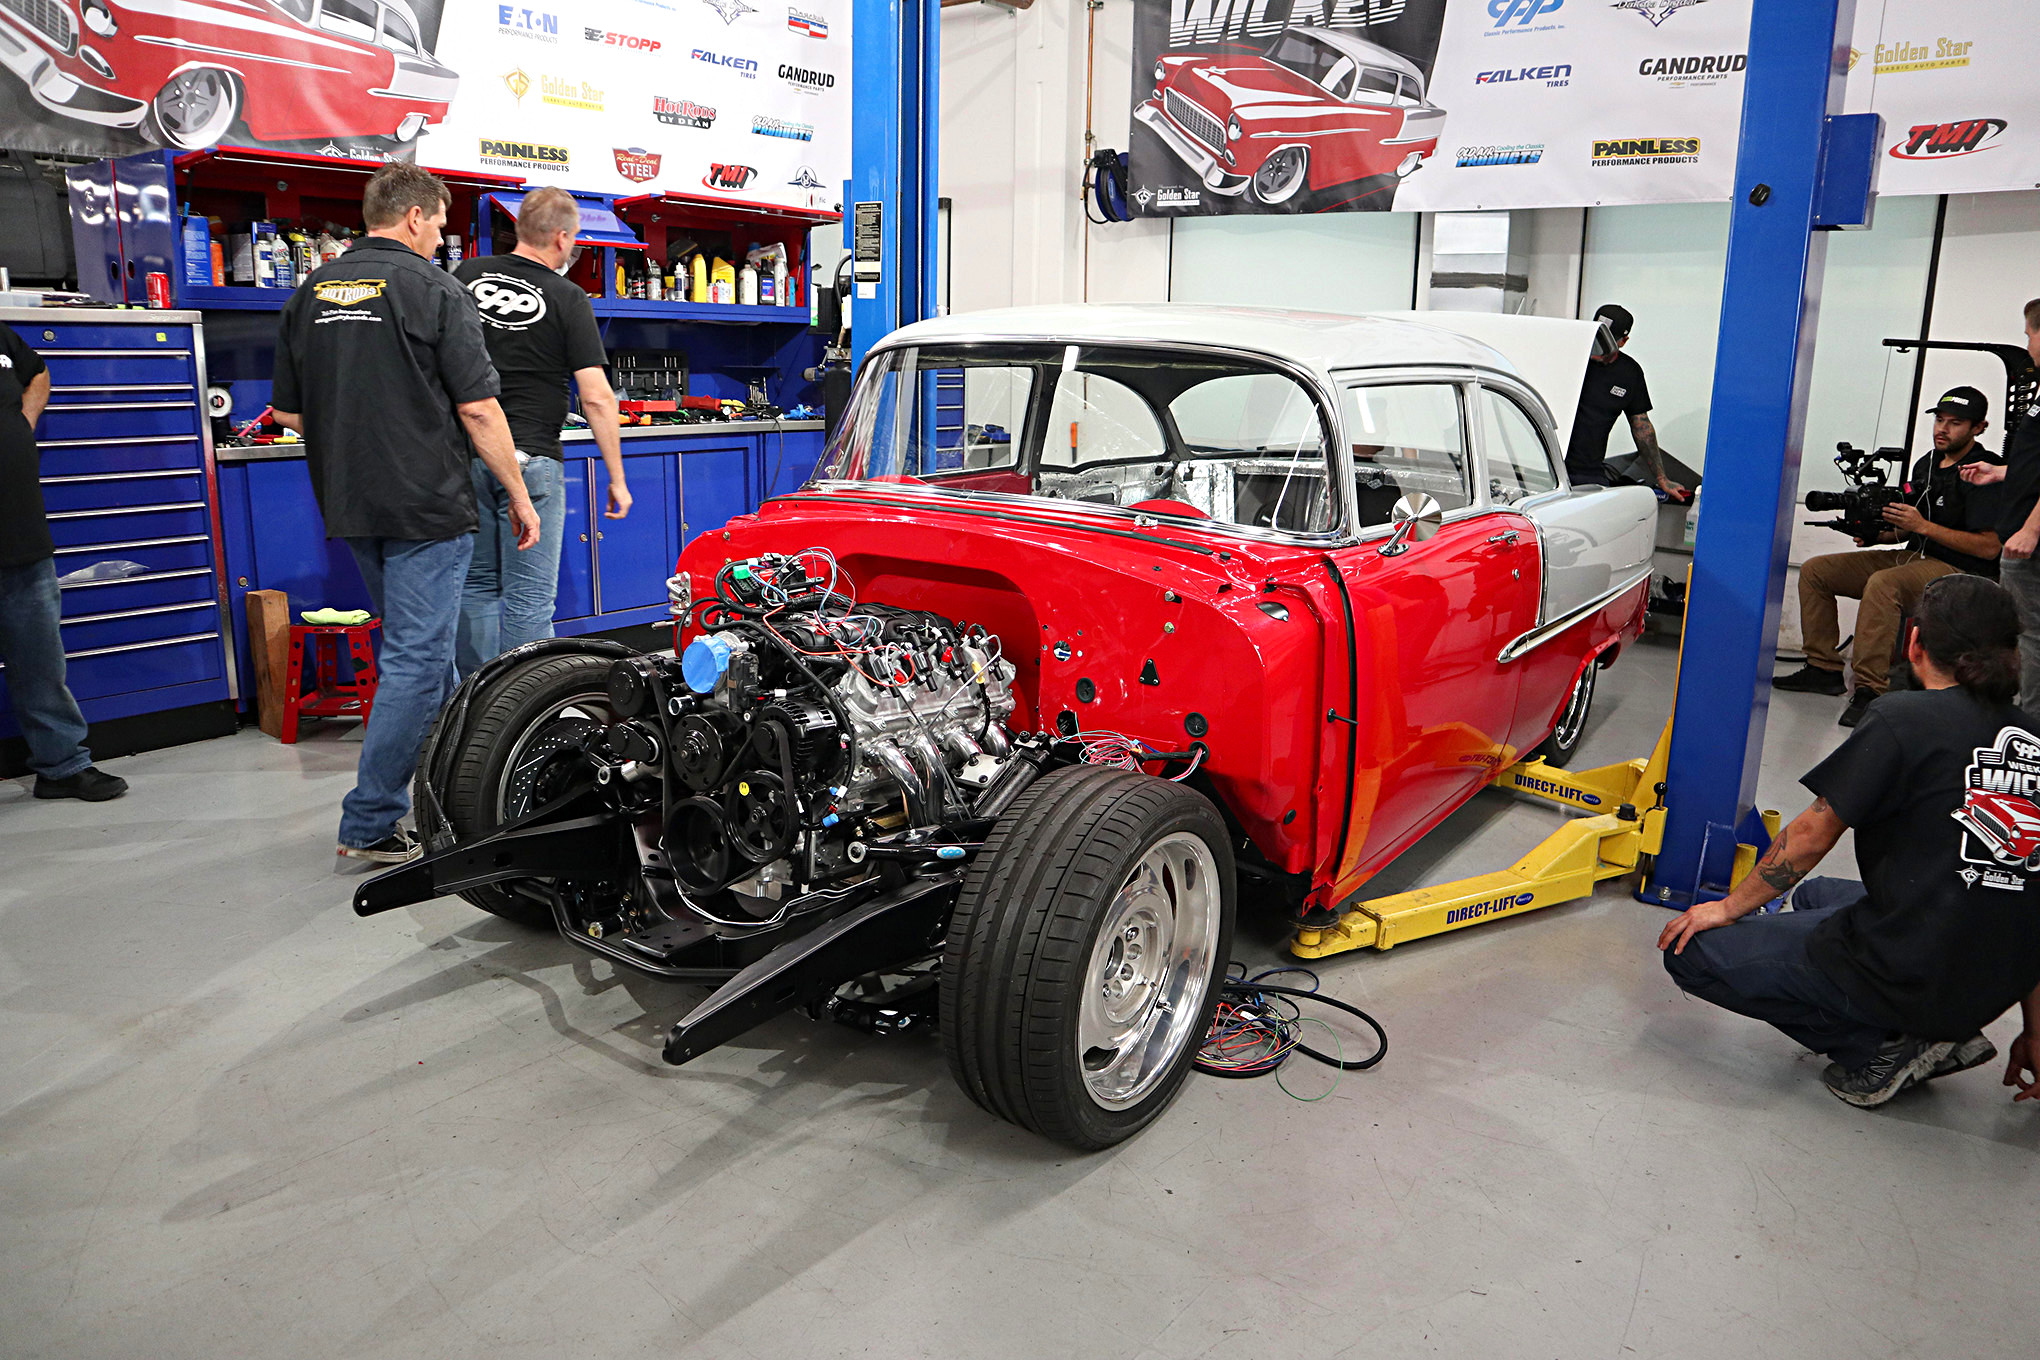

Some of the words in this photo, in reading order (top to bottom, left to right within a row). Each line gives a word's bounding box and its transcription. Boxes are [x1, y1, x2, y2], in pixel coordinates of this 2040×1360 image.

[498, 4, 558, 35] EATON
[584, 27, 662, 52] E-STOPP
[1874, 41, 1929, 64] Golden
[1936, 37, 1974, 58] Star
[691, 49, 759, 72] FALKEN
[1638, 54, 1748, 76] GANDRUD
[740, 71, 757, 80] TIRES
[778, 64, 835, 88] GANDRUD
[1475, 64, 1572, 85] FALKEN
[1546, 79, 1570, 88] TIRES
[541, 73, 578, 98] Golden
[581, 81, 605, 102] Star
[660, 115, 674, 124] BY
[678, 117, 710, 128] DEAN
[1593, 138, 1699, 157] PAINLESS
[1906, 119, 1996, 155] TMI
[479, 139, 569, 162] PAINLESS
[1455, 149, 1543, 168] PRODUCTS
[1592, 157, 1651, 167] PERFORMANCE
[1652, 155, 1699, 165] PRODUCTS
[480, 157, 532, 169] PERFORMANCE
[532, 162, 570, 173] PRODUCTS
[620, 161, 656, 179] STEEL
[710, 162, 750, 190] TMI
[1157, 188, 1183, 201] Golden
[1183, 187, 1201, 200] Star
[1514, 773, 1583, 802] DIRECT-LIFT
[1981, 768, 2040, 797] WIC
[1983, 870, 2010, 884] Golden
[2011, 874, 2026, 885] Star
[1446, 894, 1517, 925] DIRECT-LIFT
